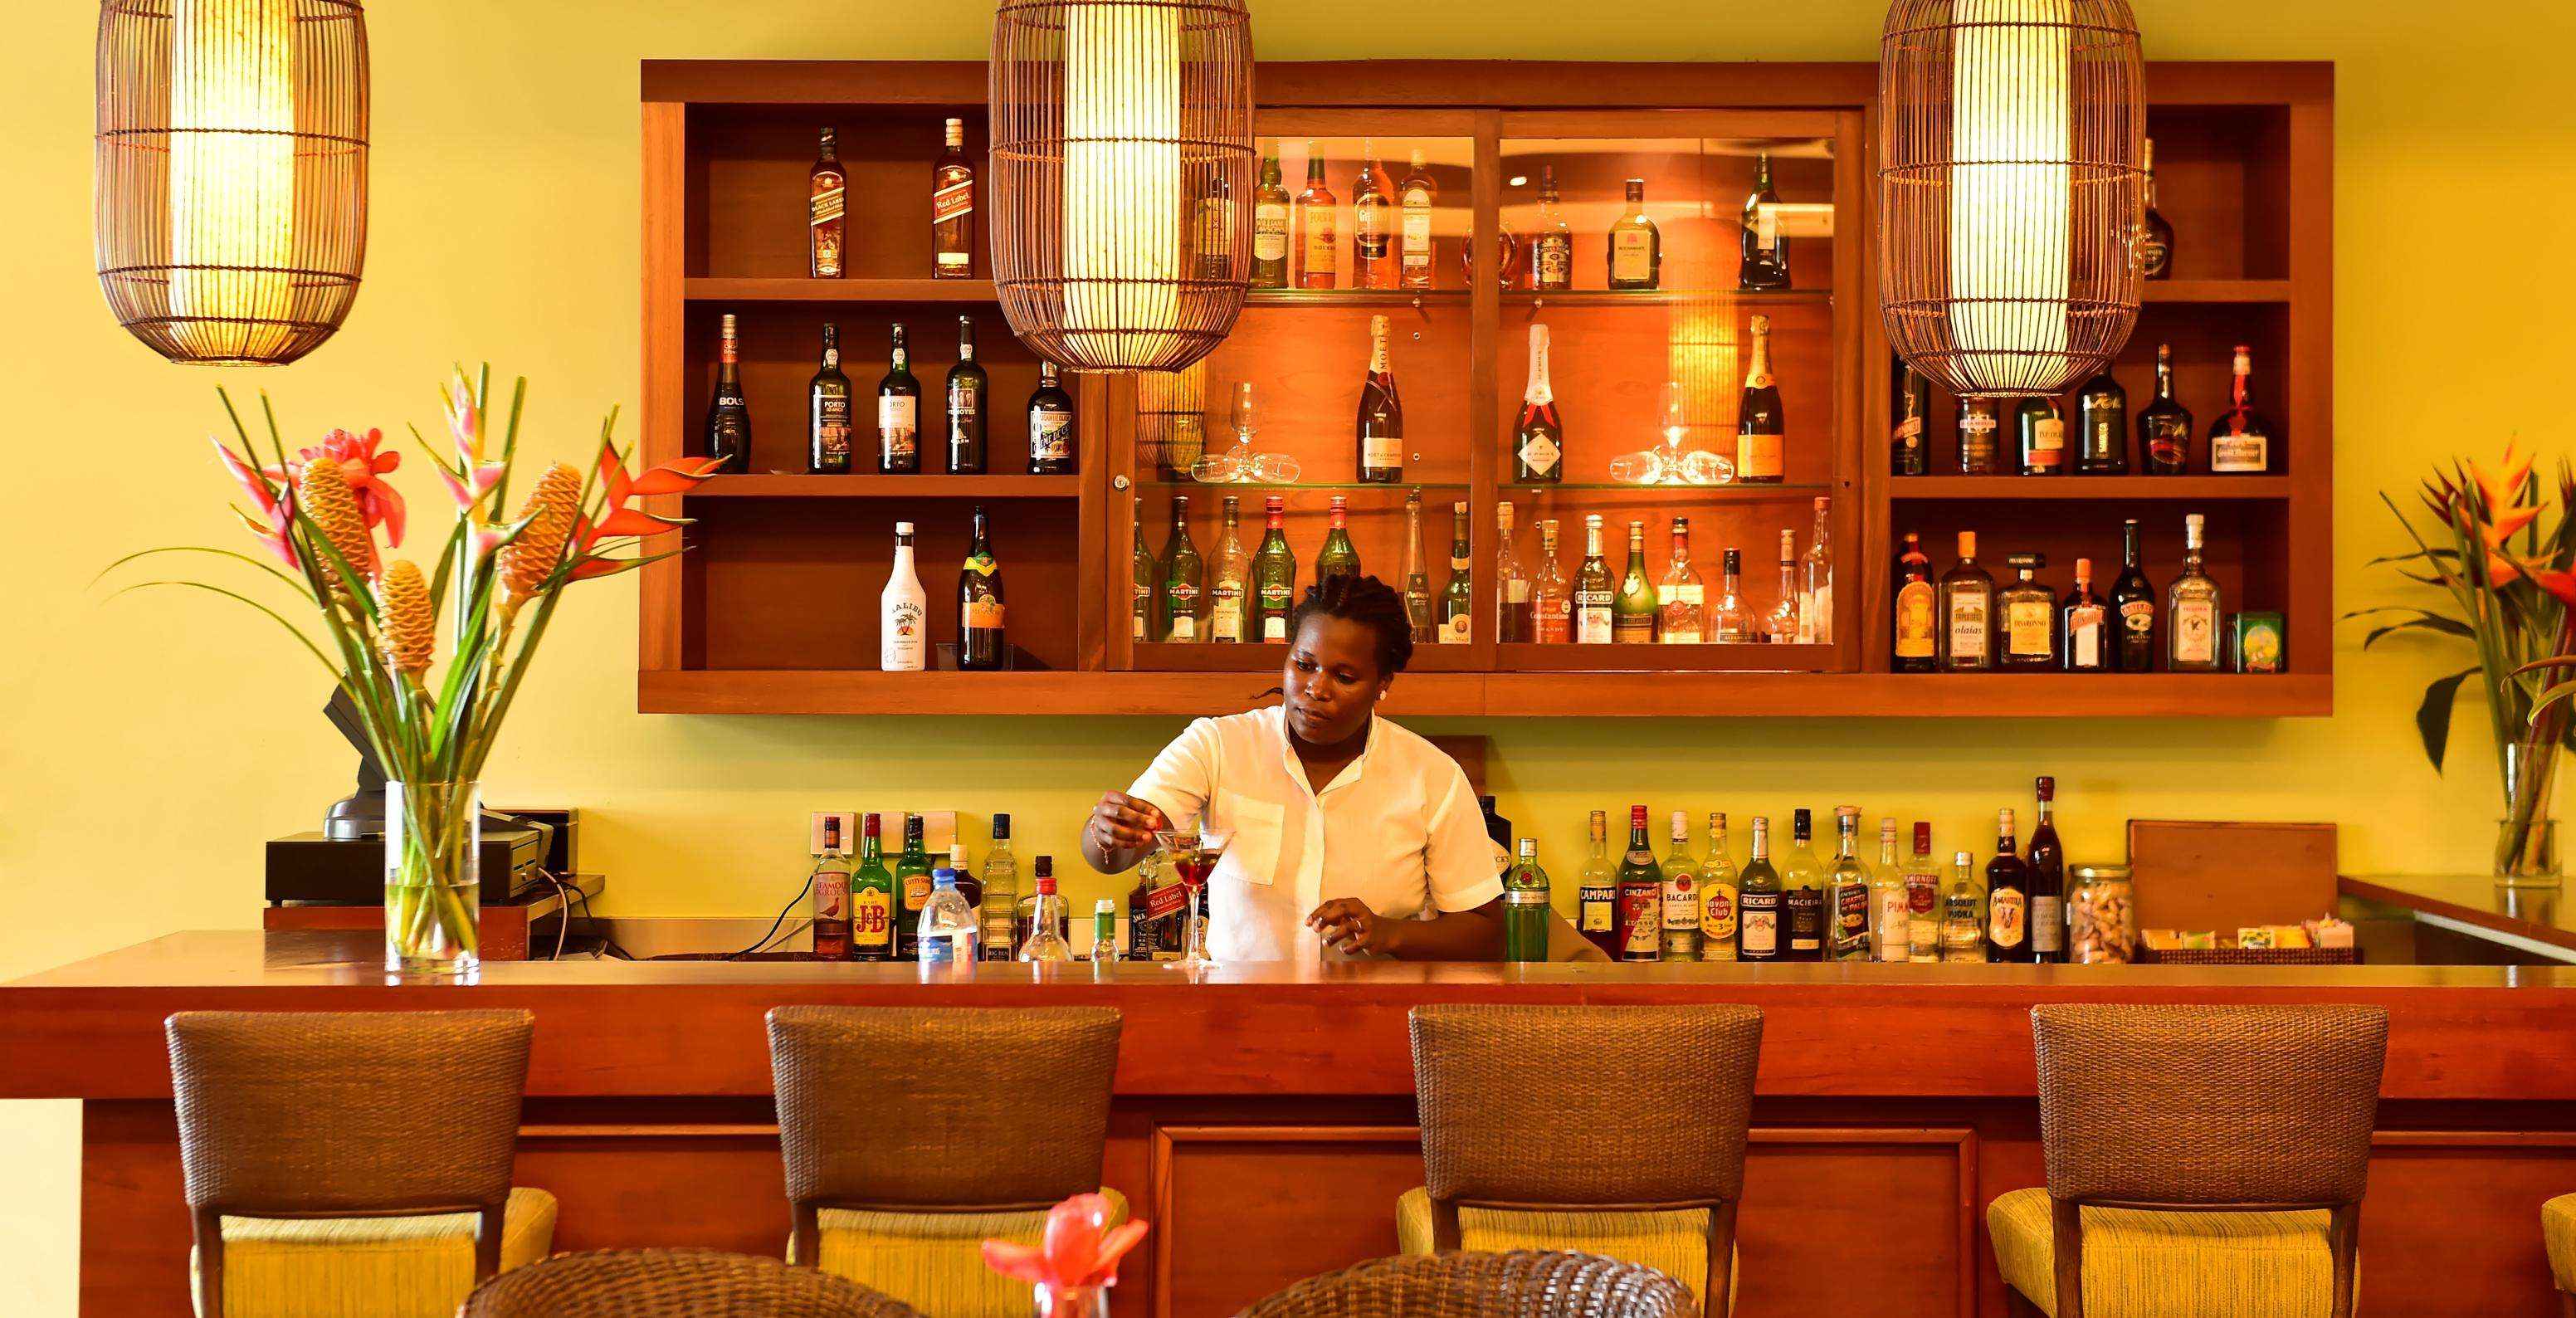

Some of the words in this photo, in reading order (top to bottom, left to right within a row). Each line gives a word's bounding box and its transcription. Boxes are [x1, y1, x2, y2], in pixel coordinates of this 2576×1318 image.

[936, 198, 951, 209] Red
[951, 191, 969, 205] Label
[719, 397, 744, 406] BOLS
[1149, 895, 1164, 908] Red
[1164, 890, 1183, 902] Label
[856, 905, 886, 933] J&B
[1710, 907, 1728, 916] Club
